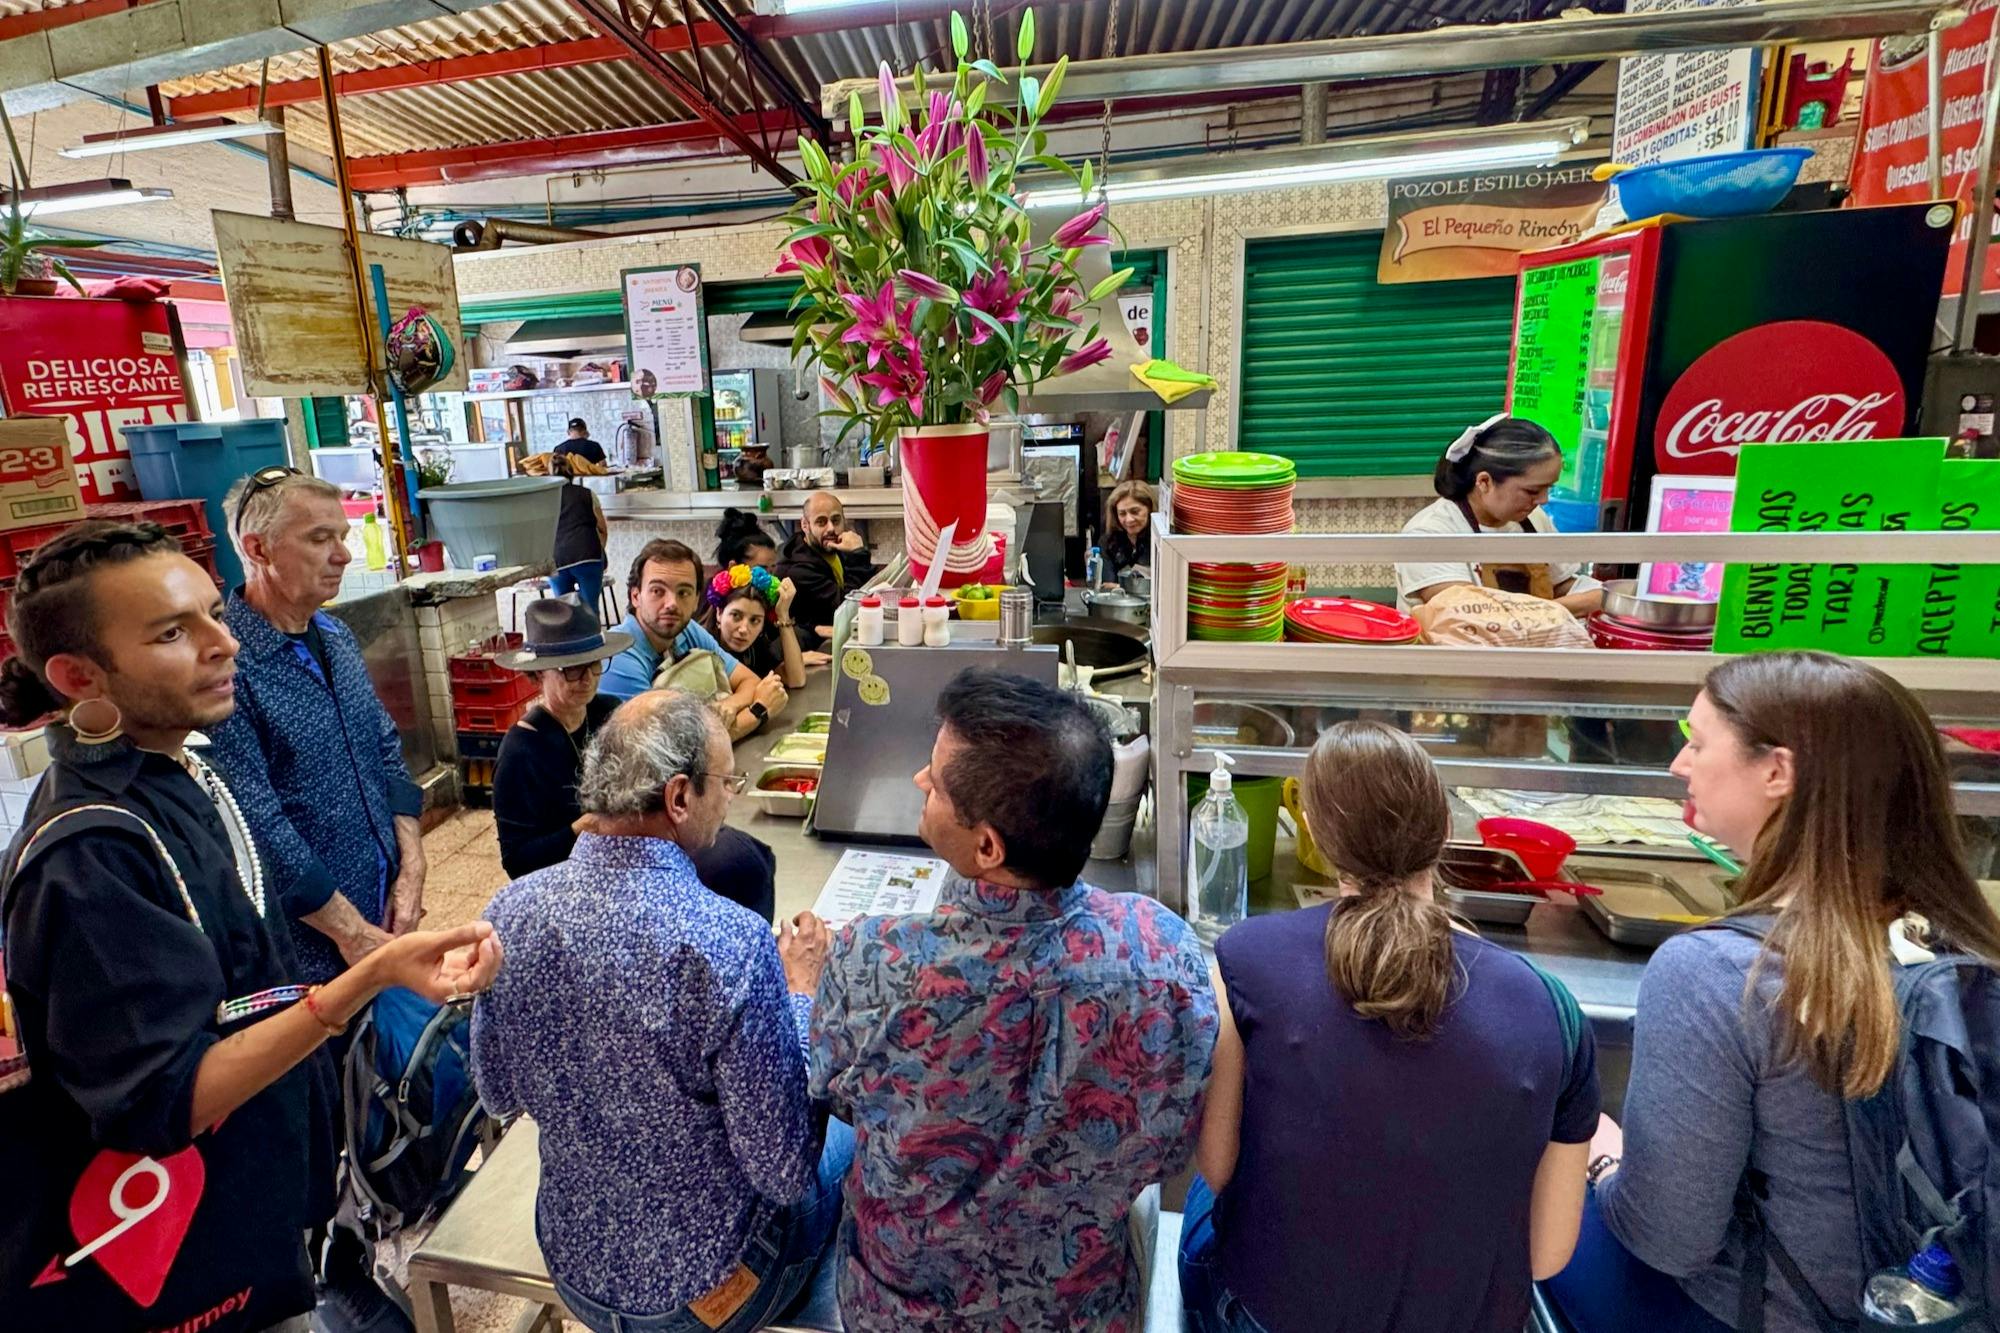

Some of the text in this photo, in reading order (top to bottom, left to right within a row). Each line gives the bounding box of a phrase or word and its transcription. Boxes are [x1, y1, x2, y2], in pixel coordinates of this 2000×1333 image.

[1674, 76, 1696, 96] PANZA
[1673, 90, 1694, 110] RAJAS
[1616, 140, 1622, 154] O
[1623, 135, 1632, 151] LA
[1688, 98, 1708, 119] QUE
[1710, 81, 1742, 110] GUSTE
[1643, 144, 1649, 158] Y
[1394, 178, 1469, 199] POZOLE
[1474, 172, 1542, 193] ESTILO
[1422, 217, 1582, 240] El Pequeño Rincón
[1127, 306, 1149, 320] de
[27, 358, 169, 380] DELICIOSA
[22, 375, 182, 399] REFRESCANTE
[107, 396, 117, 407] Y
[1665, 392, 1897, 458] Coca-Cola
[1820, 492, 1874, 633] TARJAS
